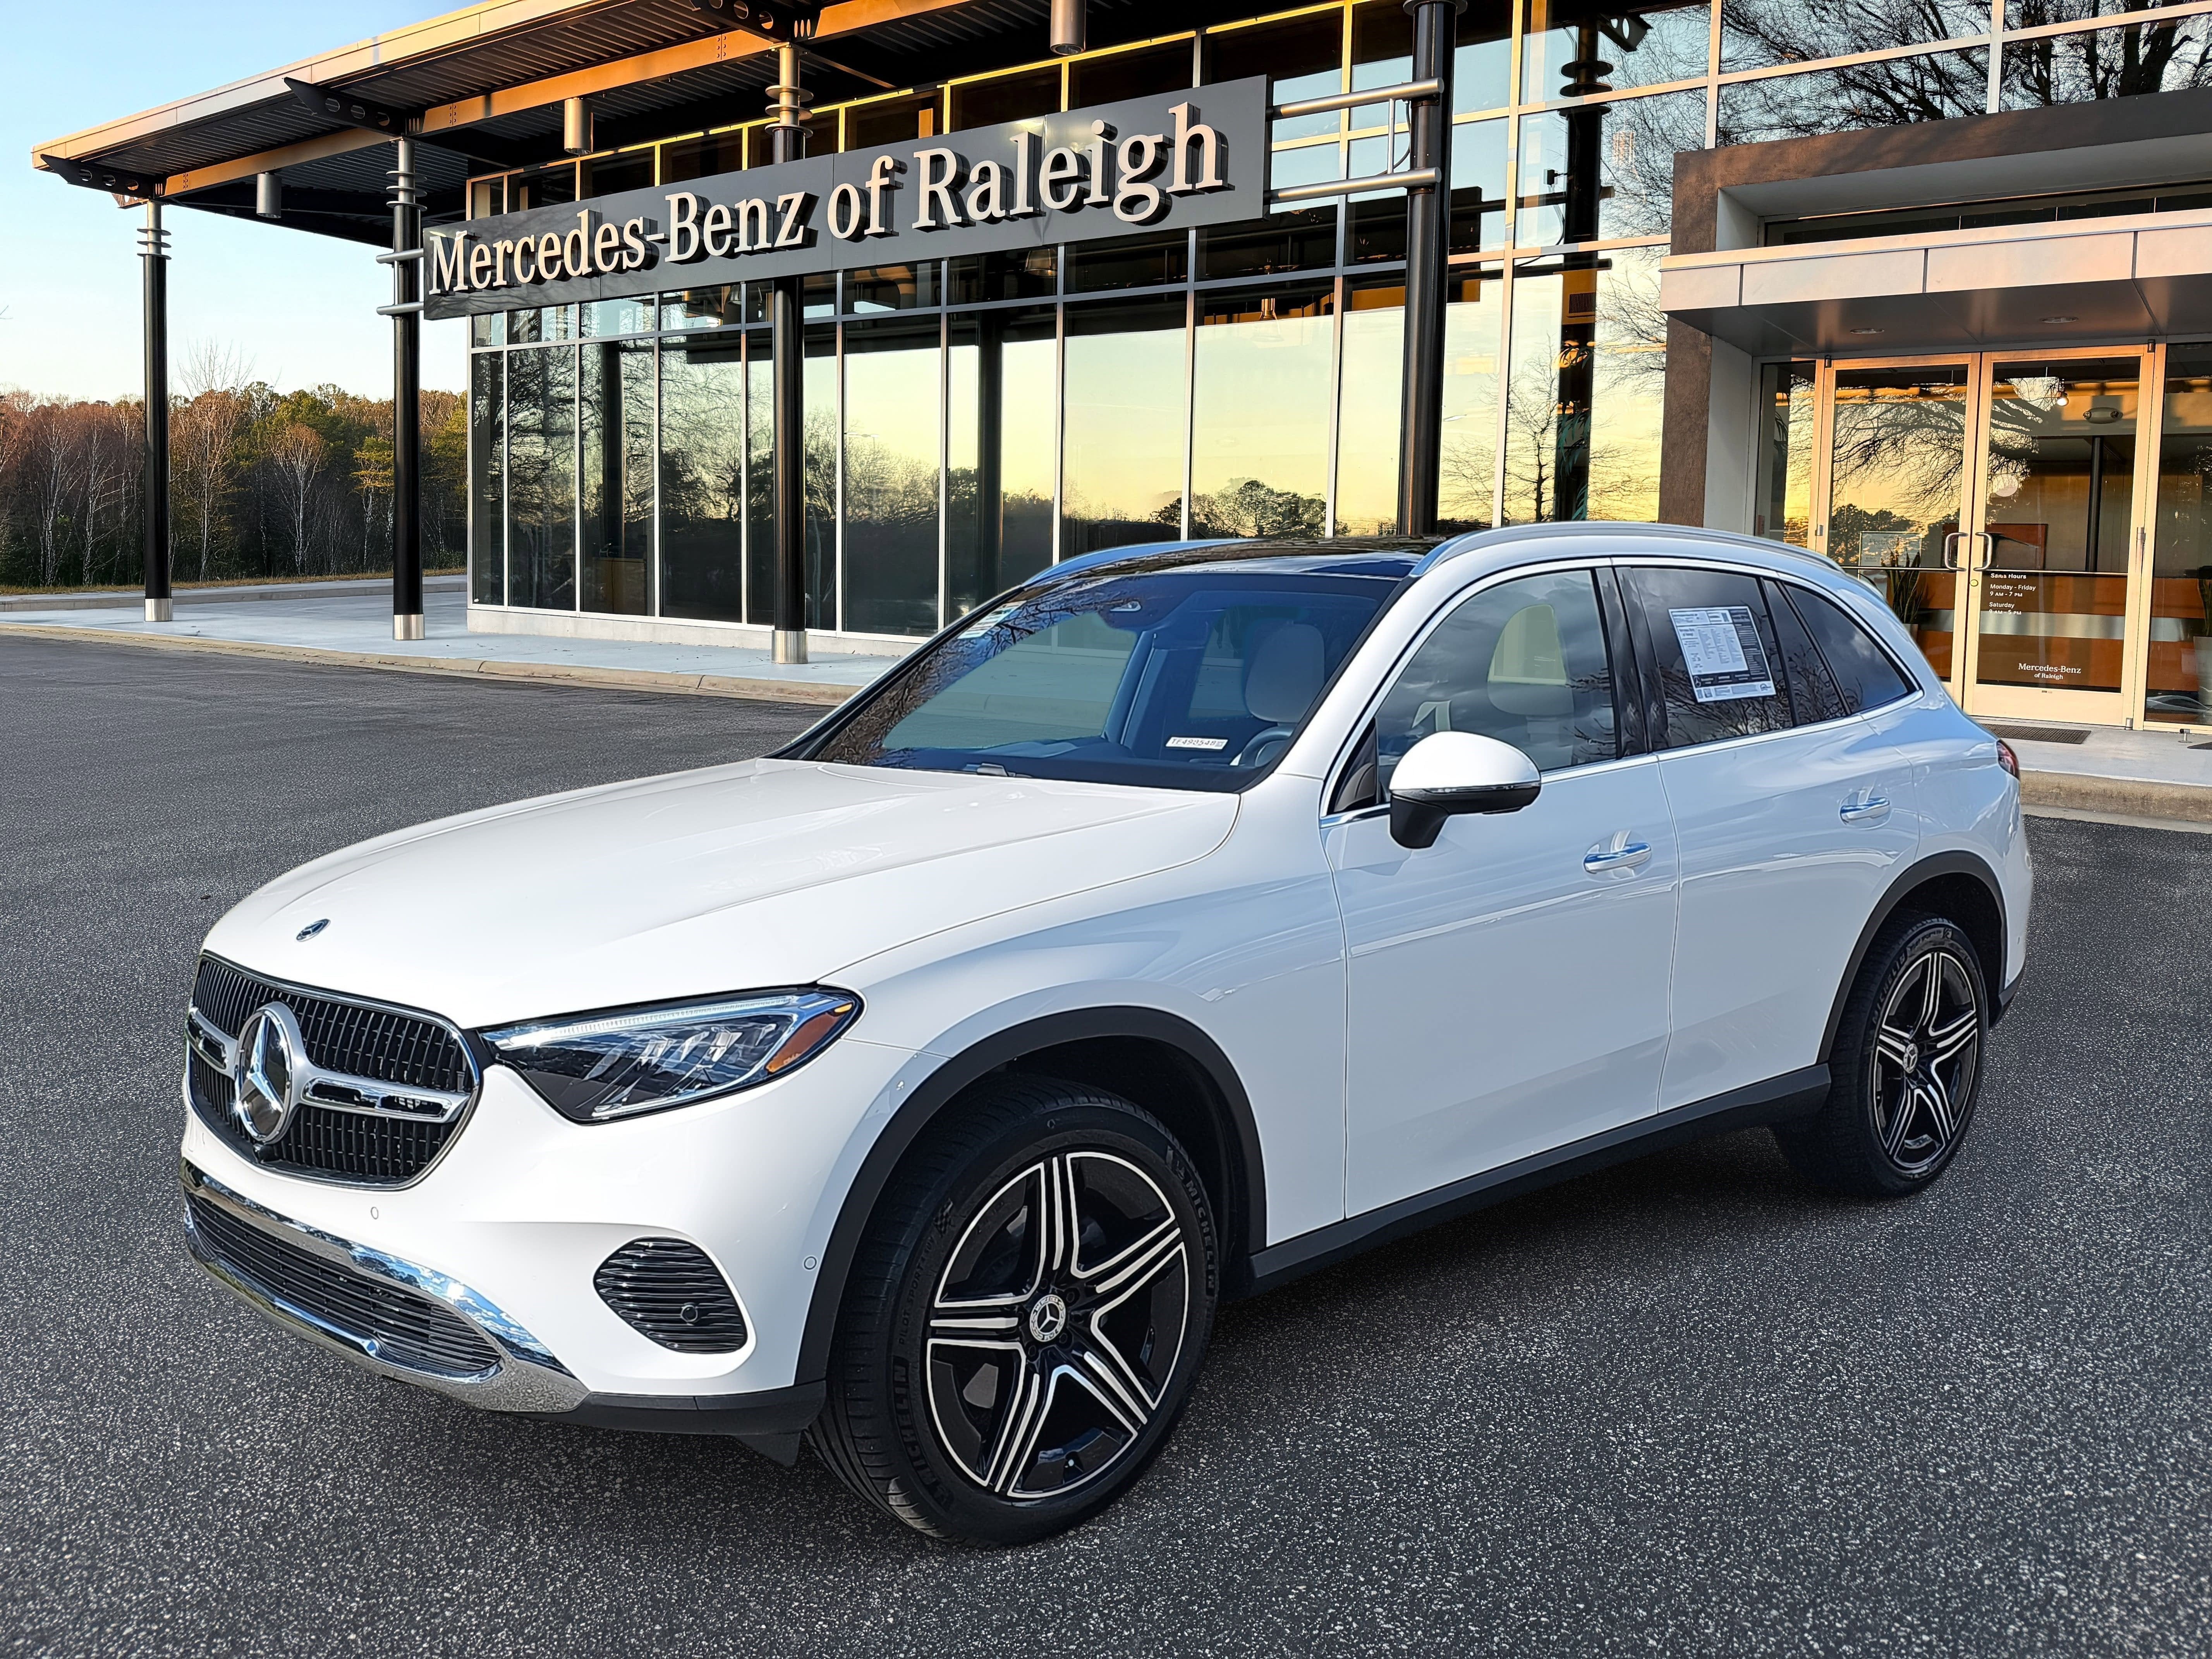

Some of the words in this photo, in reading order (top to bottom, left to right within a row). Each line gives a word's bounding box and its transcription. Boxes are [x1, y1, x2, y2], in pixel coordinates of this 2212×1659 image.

[429, 191, 805, 295] Mercedes-Benz
[827, 155, 894, 239] of
[912, 101, 1223, 223] Raleigh
[2018, 663, 2081, 674] Mercedes-Benz
[1185, 1181, 1215, 1288] MICHELIN
[899, 1309, 911, 1345] PILOT
[908, 1263, 924, 1306] SPORT
[894, 1364, 936, 1486] MICHELIN
